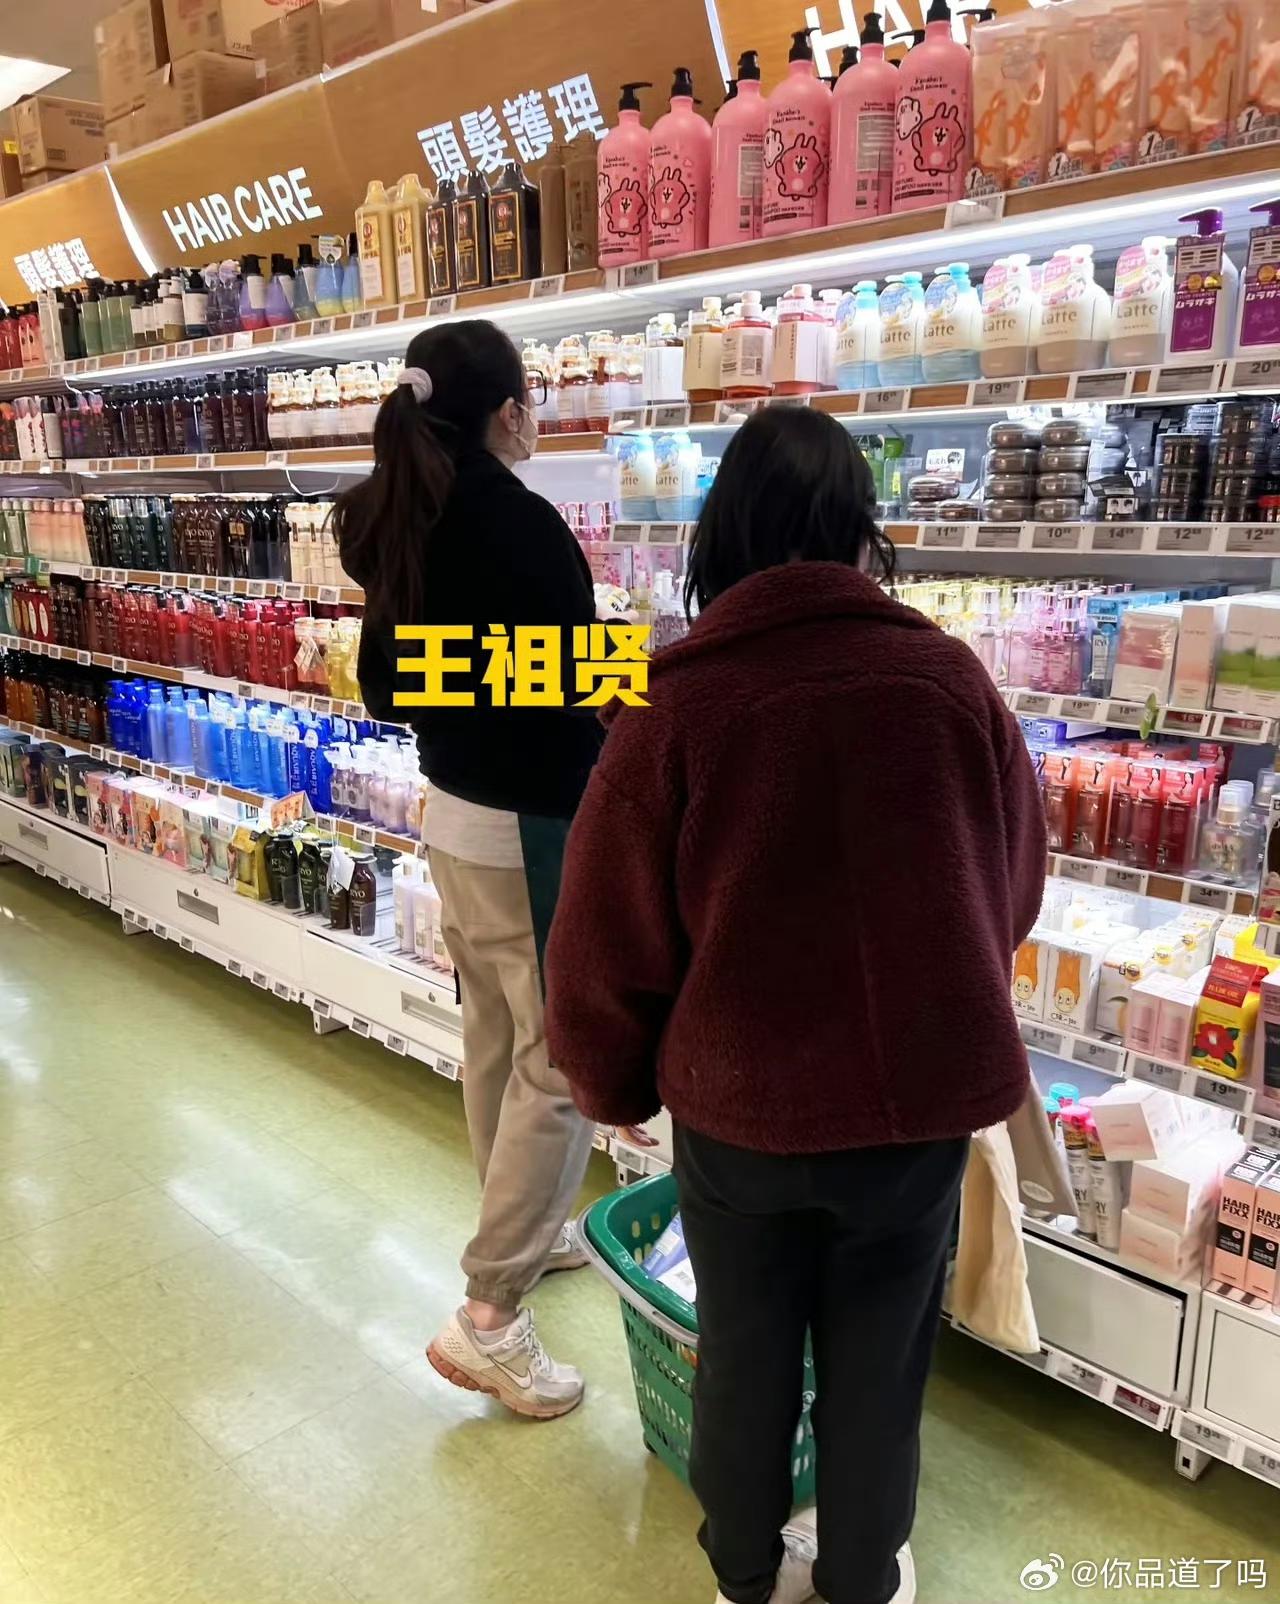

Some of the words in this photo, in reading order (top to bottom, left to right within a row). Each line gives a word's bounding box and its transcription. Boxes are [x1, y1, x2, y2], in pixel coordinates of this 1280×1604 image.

[417, 73, 609, 184] 頭髮護理
[162, 193, 243, 253] HAIR
[234, 166, 324, 233] CARE
[1041, 308, 1078, 326] Latte
[1117, 303, 1158, 319] Latte
[924, 323, 955, 338] Latte
[983, 316, 1017, 333] Latte
[881, 330, 911, 343] Latte
[1222, 1205, 1249, 1219] FIXX
[1223, 1196, 1250, 1212] HAIR
